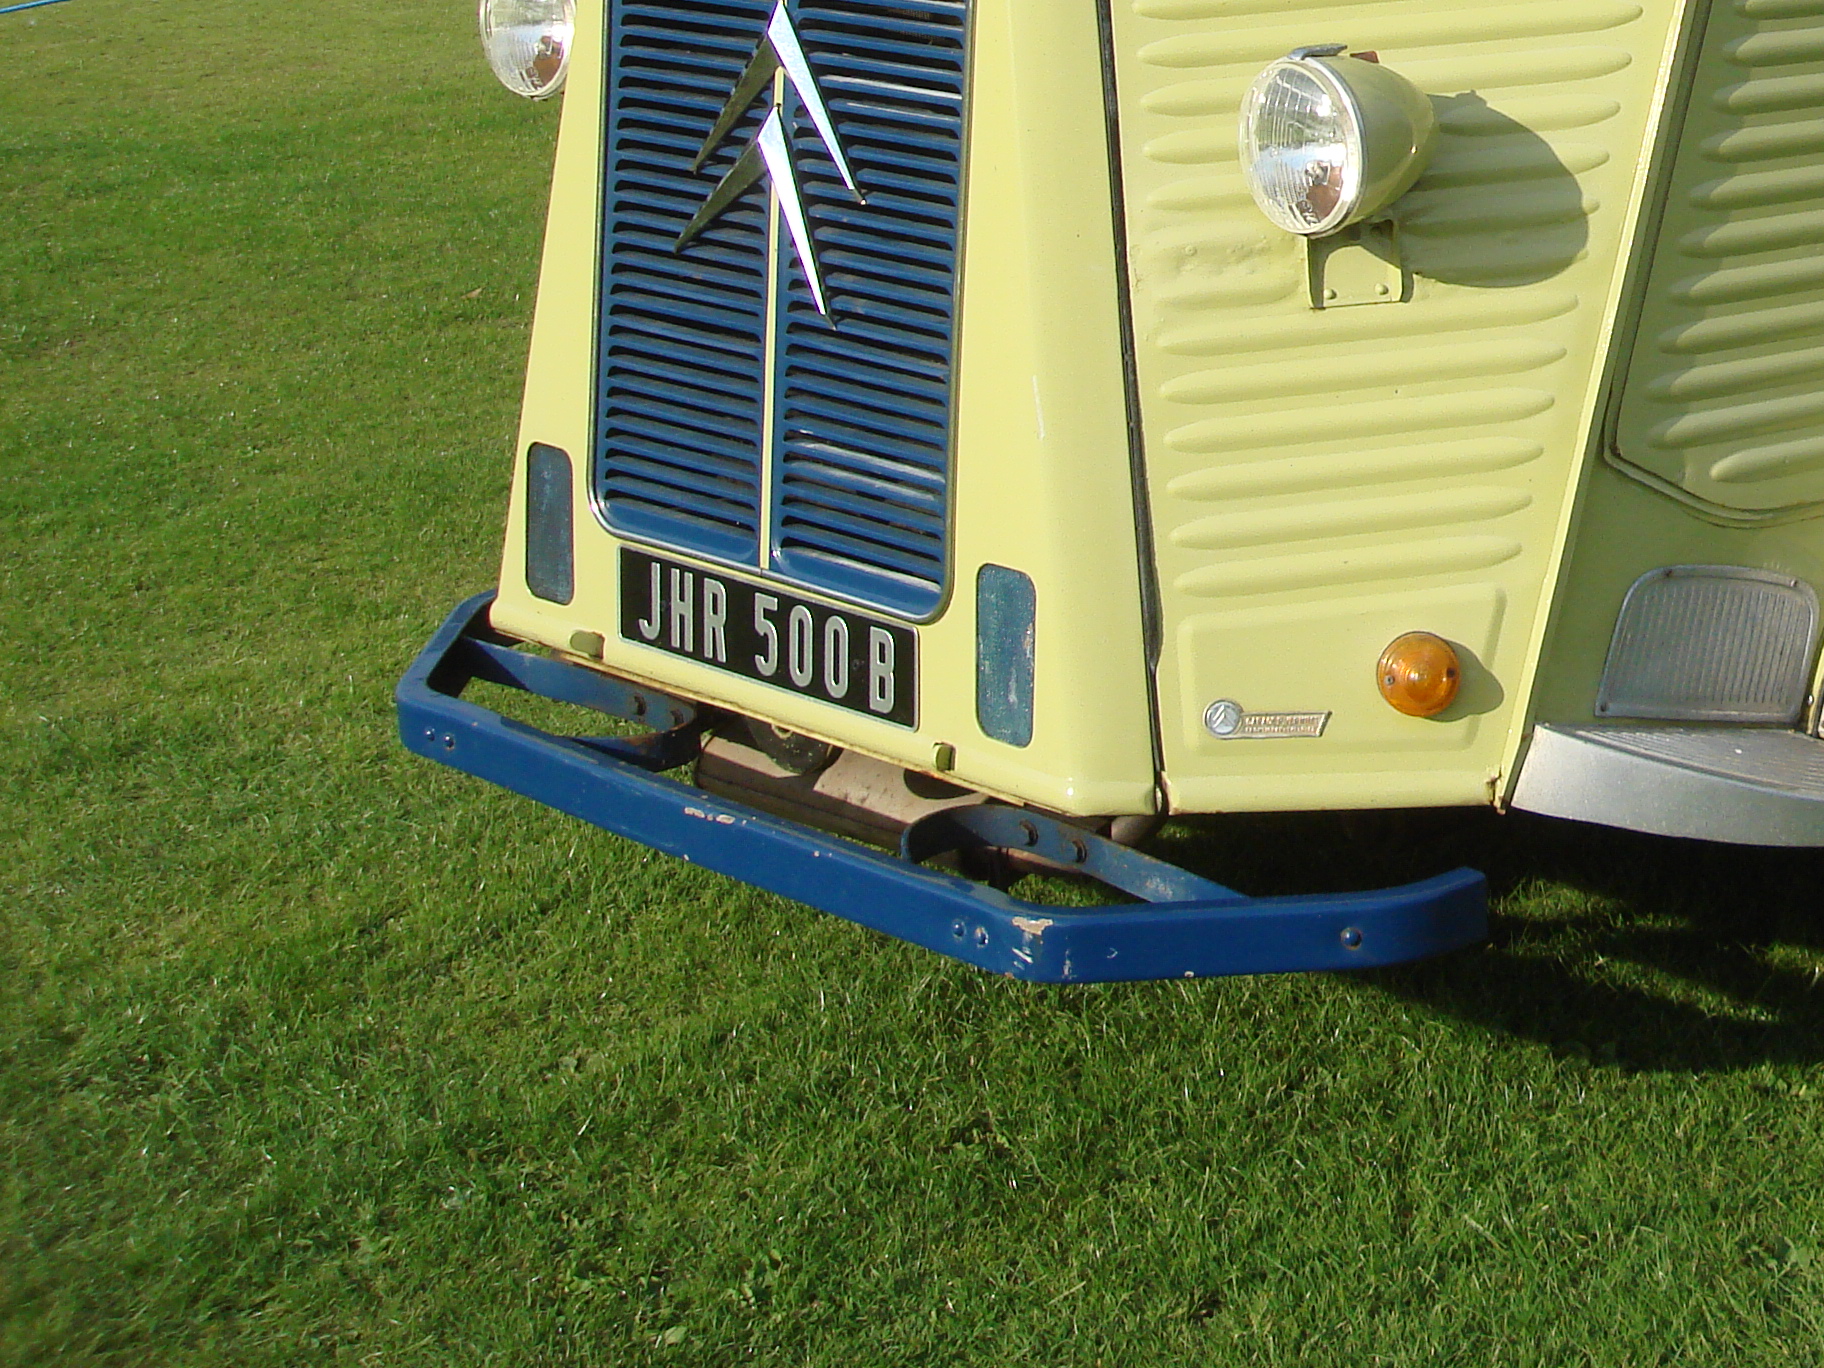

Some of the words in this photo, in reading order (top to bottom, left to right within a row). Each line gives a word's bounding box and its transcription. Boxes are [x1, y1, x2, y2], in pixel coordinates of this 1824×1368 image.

[638, 561, 727, 664] JHR
[753, 591, 849, 699] 500
[868, 625, 895, 714] B
